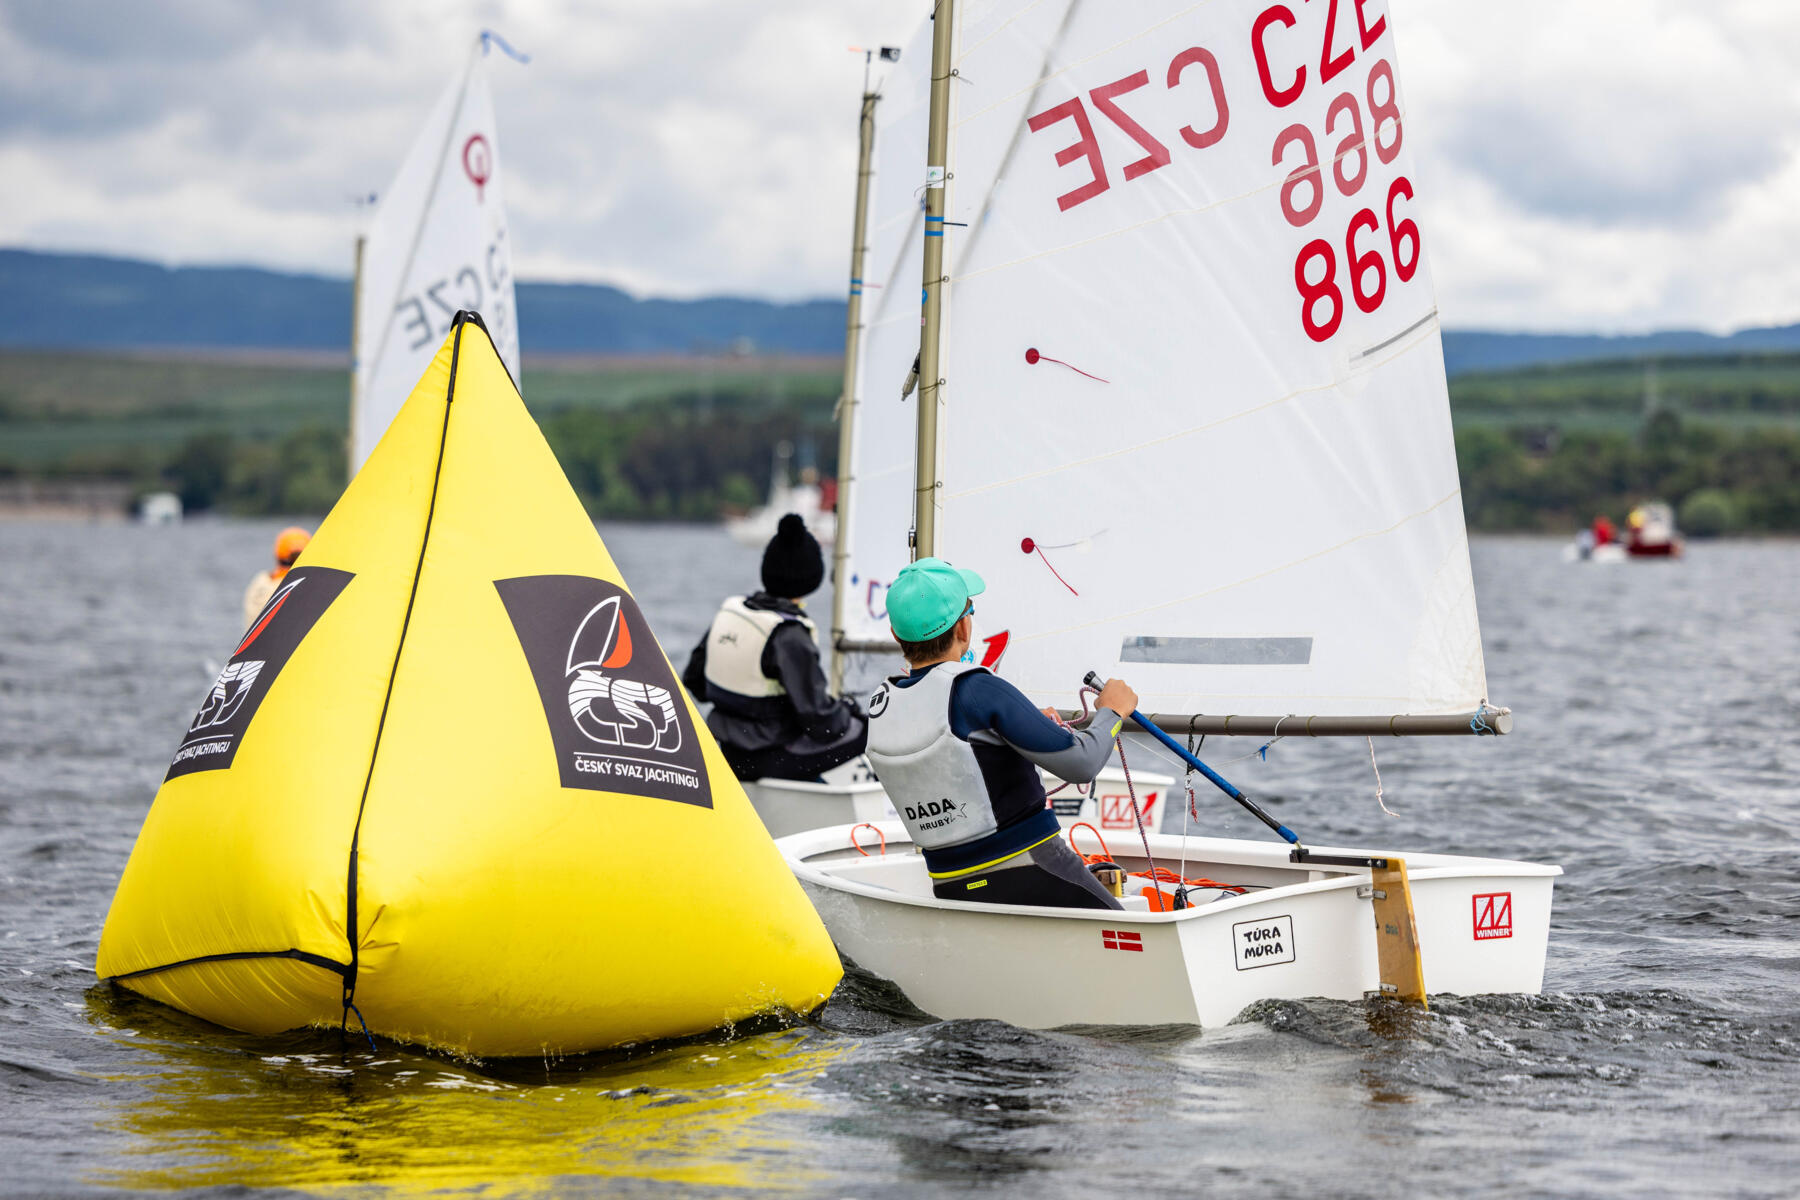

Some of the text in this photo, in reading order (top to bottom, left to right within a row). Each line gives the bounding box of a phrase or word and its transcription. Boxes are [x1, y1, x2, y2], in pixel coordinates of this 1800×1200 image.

[1295, 176, 1421, 342] 866
[575, 756, 699, 789] ČESKÝ SVAZ JACHTINGU
[905, 798, 956, 821] DÁDA
[1243, 926, 1281, 943] TÚRA
